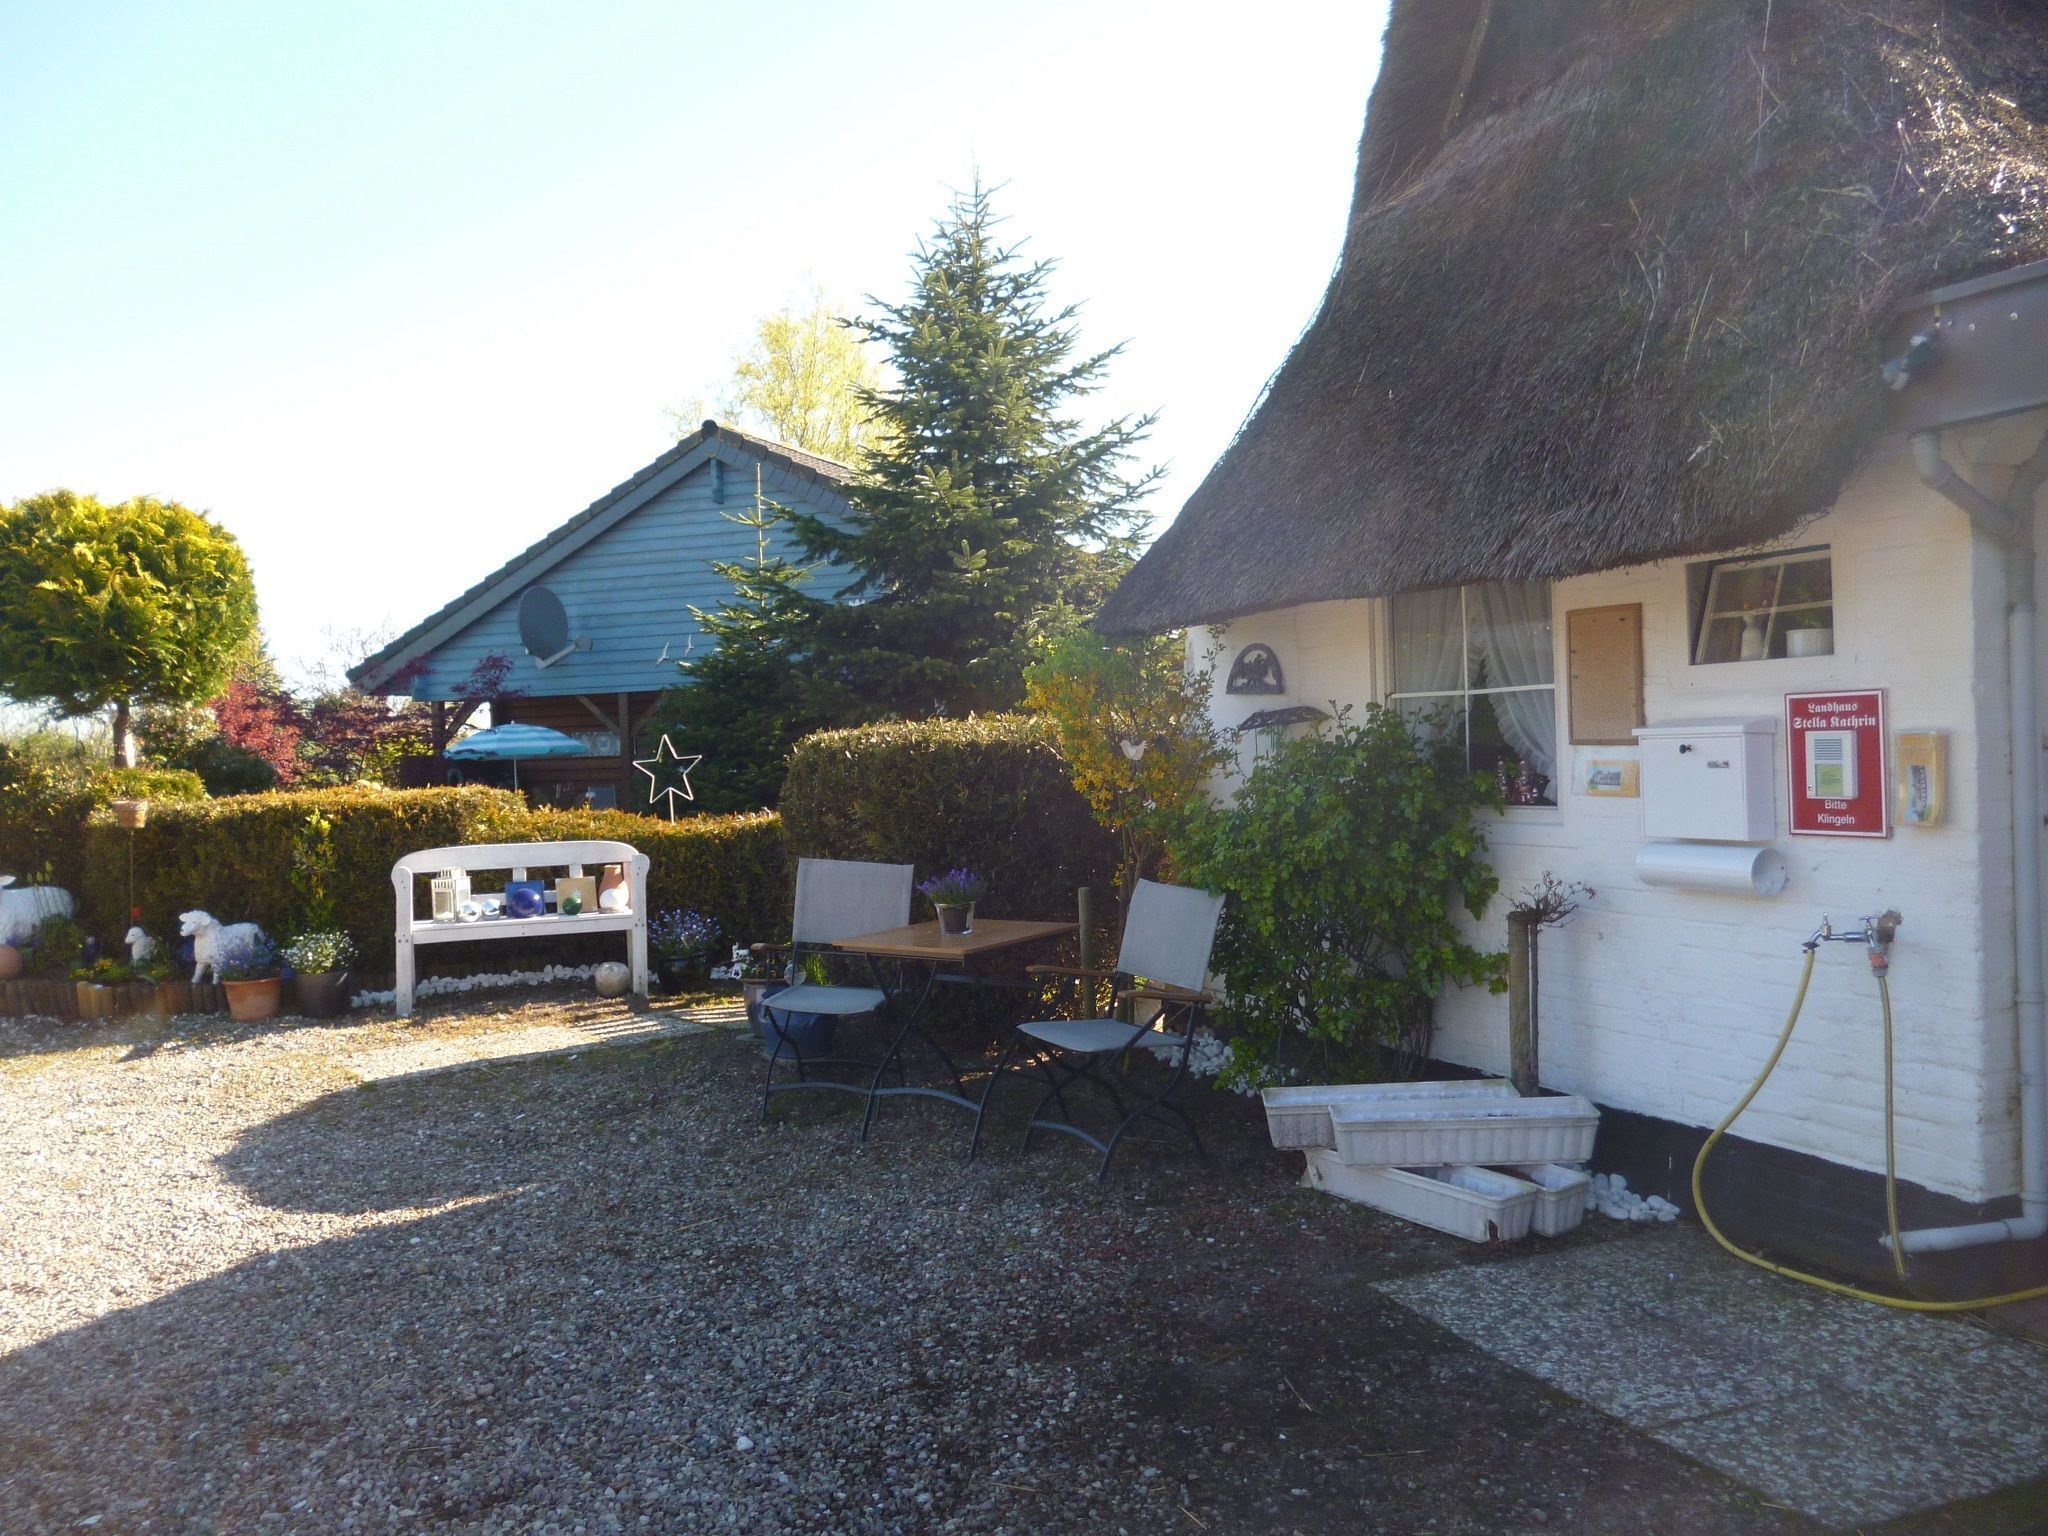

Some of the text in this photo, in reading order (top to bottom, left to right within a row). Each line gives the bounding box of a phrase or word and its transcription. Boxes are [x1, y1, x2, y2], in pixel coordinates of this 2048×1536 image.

[1808, 702, 1858, 713] Landhaus
[1793, 714, 1876, 729] Stella Kathrin
[1824, 799, 1847, 810] Bitte
[1817, 813, 1855, 826] Klingeln
